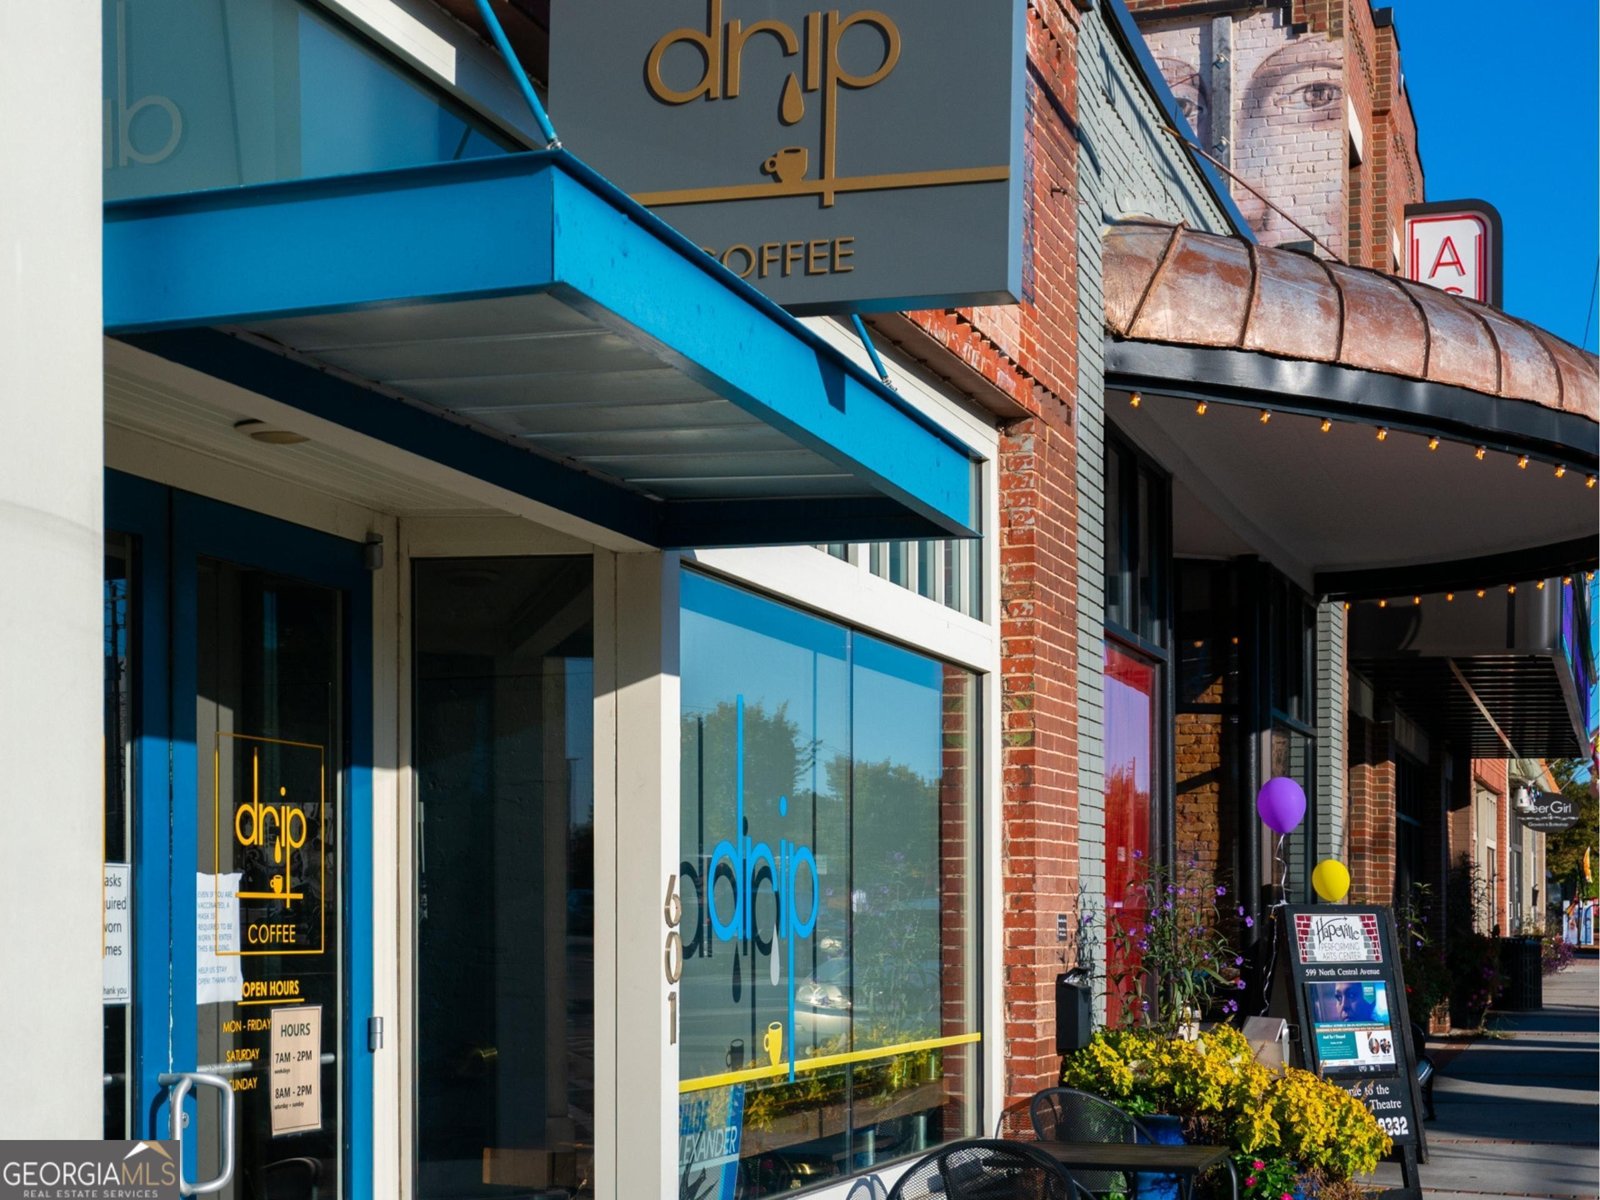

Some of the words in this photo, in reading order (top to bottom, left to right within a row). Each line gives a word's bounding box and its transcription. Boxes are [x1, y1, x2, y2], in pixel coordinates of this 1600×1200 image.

[645, 0, 901, 206] drip
[704, 236, 855, 279] OFFEE
[1550, 800, 1572, 814] Girl
[235, 747, 307, 909] drip
[708, 694, 819, 1083] drip
[248, 923, 296, 944] COFFEE
[1315, 917, 1360, 946] Hapeville
[1321, 942, 1360, 952] PERFORMING
[664, 874, 683, 1047] 601
[1322, 952, 1337, 961] ARTS
[1339, 952, 1362, 960] CENTER
[1305, 968, 1317, 977] 599
[1319, 968, 1336, 976] North
[1337, 967, 1358, 976] Central
[1360, 967, 1380, 976] Avenue
[117, 986, 127, 996] you
[242, 981, 267, 997] OPEN
[269, 980, 299, 996] HOURS
[223, 1020, 242, 1033] MON
[247, 1018, 272, 1032] FRIDAY
[281, 1023, 311, 1038] HOURS
[226, 1048, 260, 1063] SATURDAY
[275, 1052, 291, 1064] 7AM
[297, 1050, 313, 1062] 2PM
[275, 1087, 291, 1099] 8AM
[297, 1085, 313, 1097] 2PM
[1376, 1084, 1390, 1095] the
[1369, 1099, 1402, 1110] Theatre
[679, 1125, 738, 1166] LEXANDER
